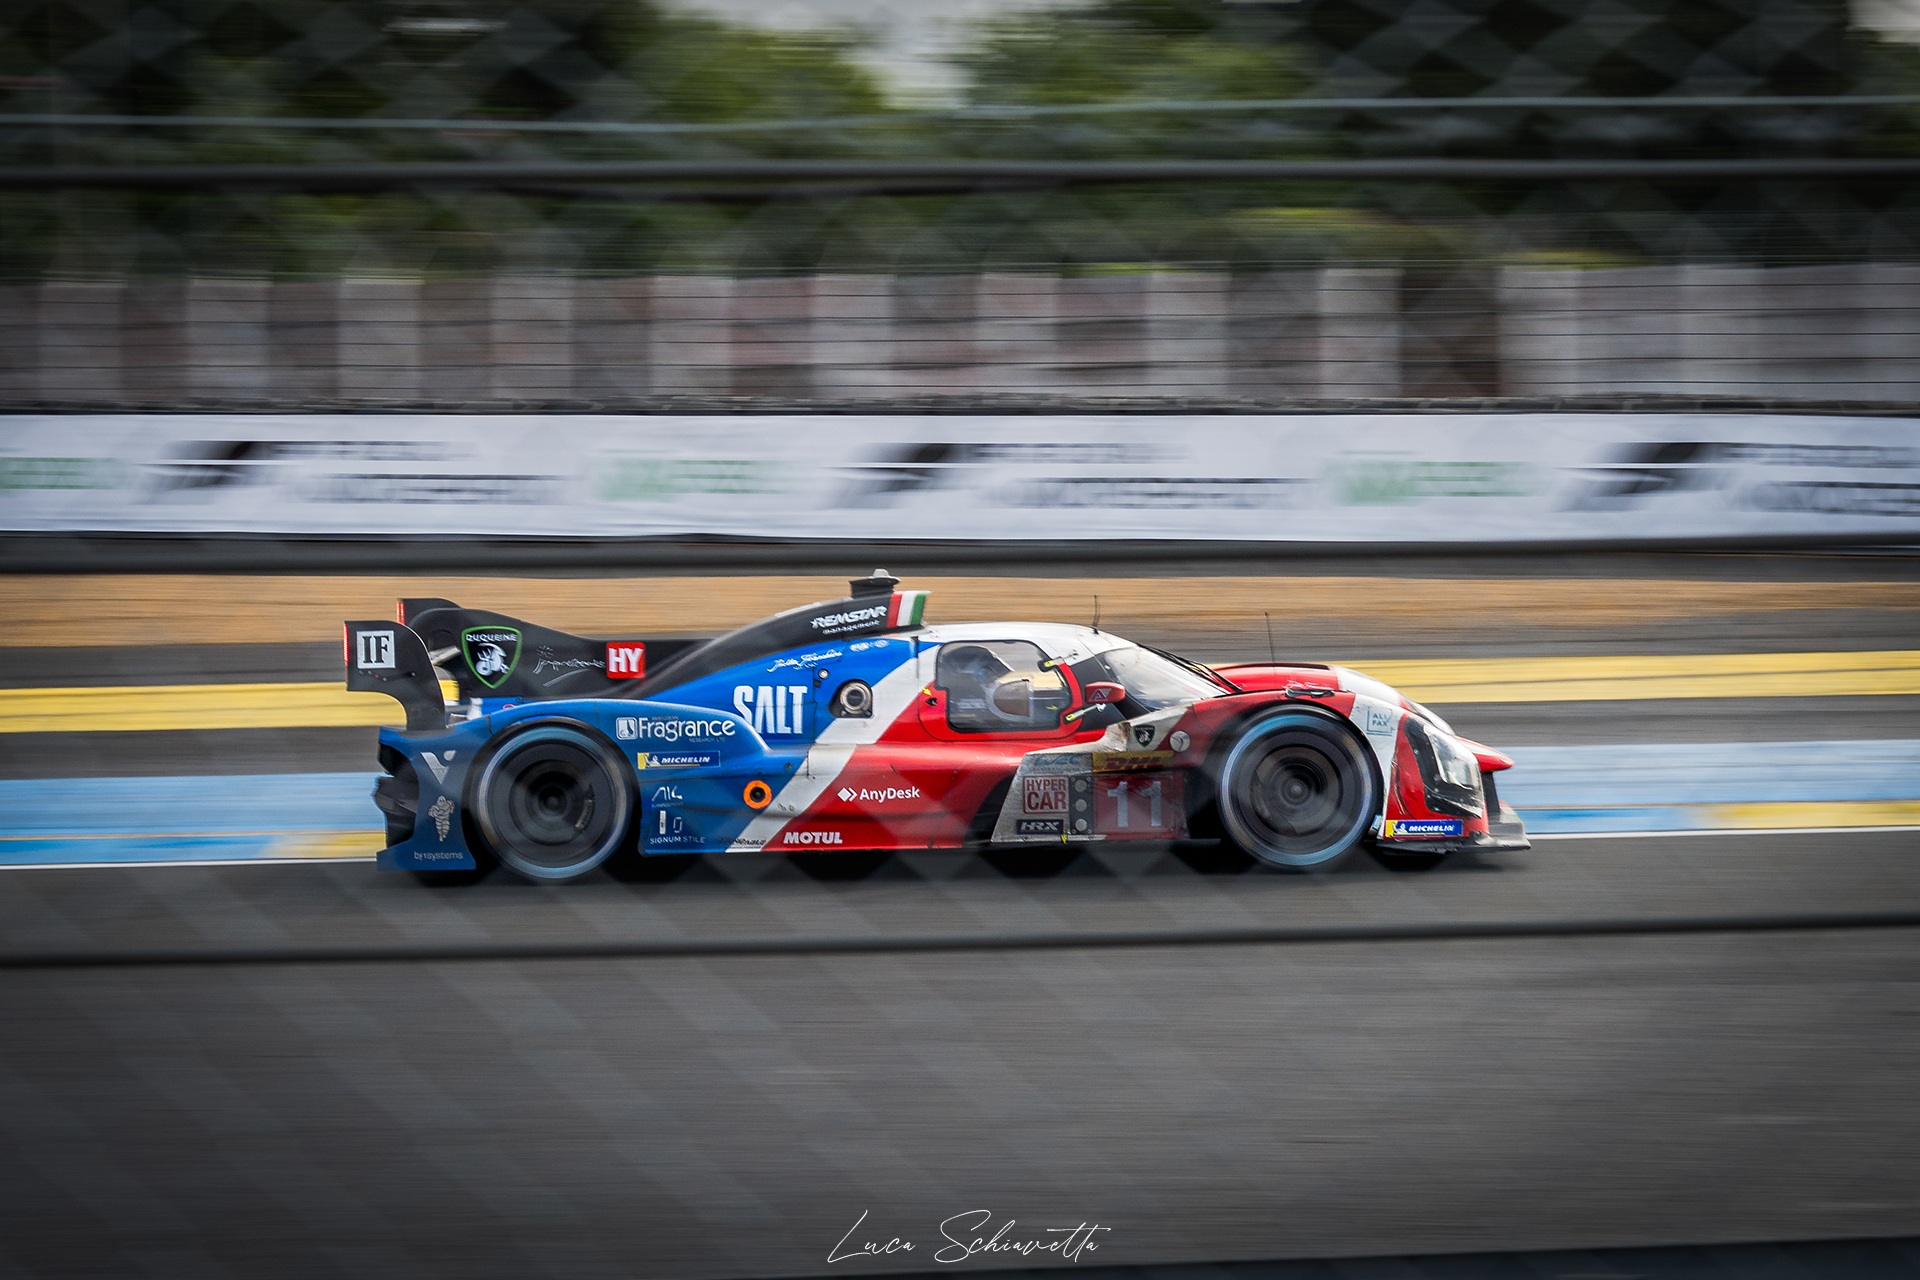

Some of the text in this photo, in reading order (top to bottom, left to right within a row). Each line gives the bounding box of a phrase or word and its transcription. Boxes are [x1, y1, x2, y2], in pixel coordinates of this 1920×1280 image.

[466, 633, 518, 642] DUQUEINE
[362, 635, 390, 664] IF
[608, 648, 644, 673] HY
[733, 685, 808, 734] SALT
[639, 717, 736, 742] Fragrance
[661, 756, 711, 765] MICHELIN
[1104, 757, 1161, 770] DHL
[1026, 779, 1067, 791] HYPER
[859, 785, 920, 803] AnyDesk
[1026, 791, 1067, 810] CAR
[1107, 781, 1162, 827] 11
[1020, 821, 1060, 832] HRX
[1408, 824, 1456, 832] MICHELIN
[783, 831, 844, 844] MOTUL
